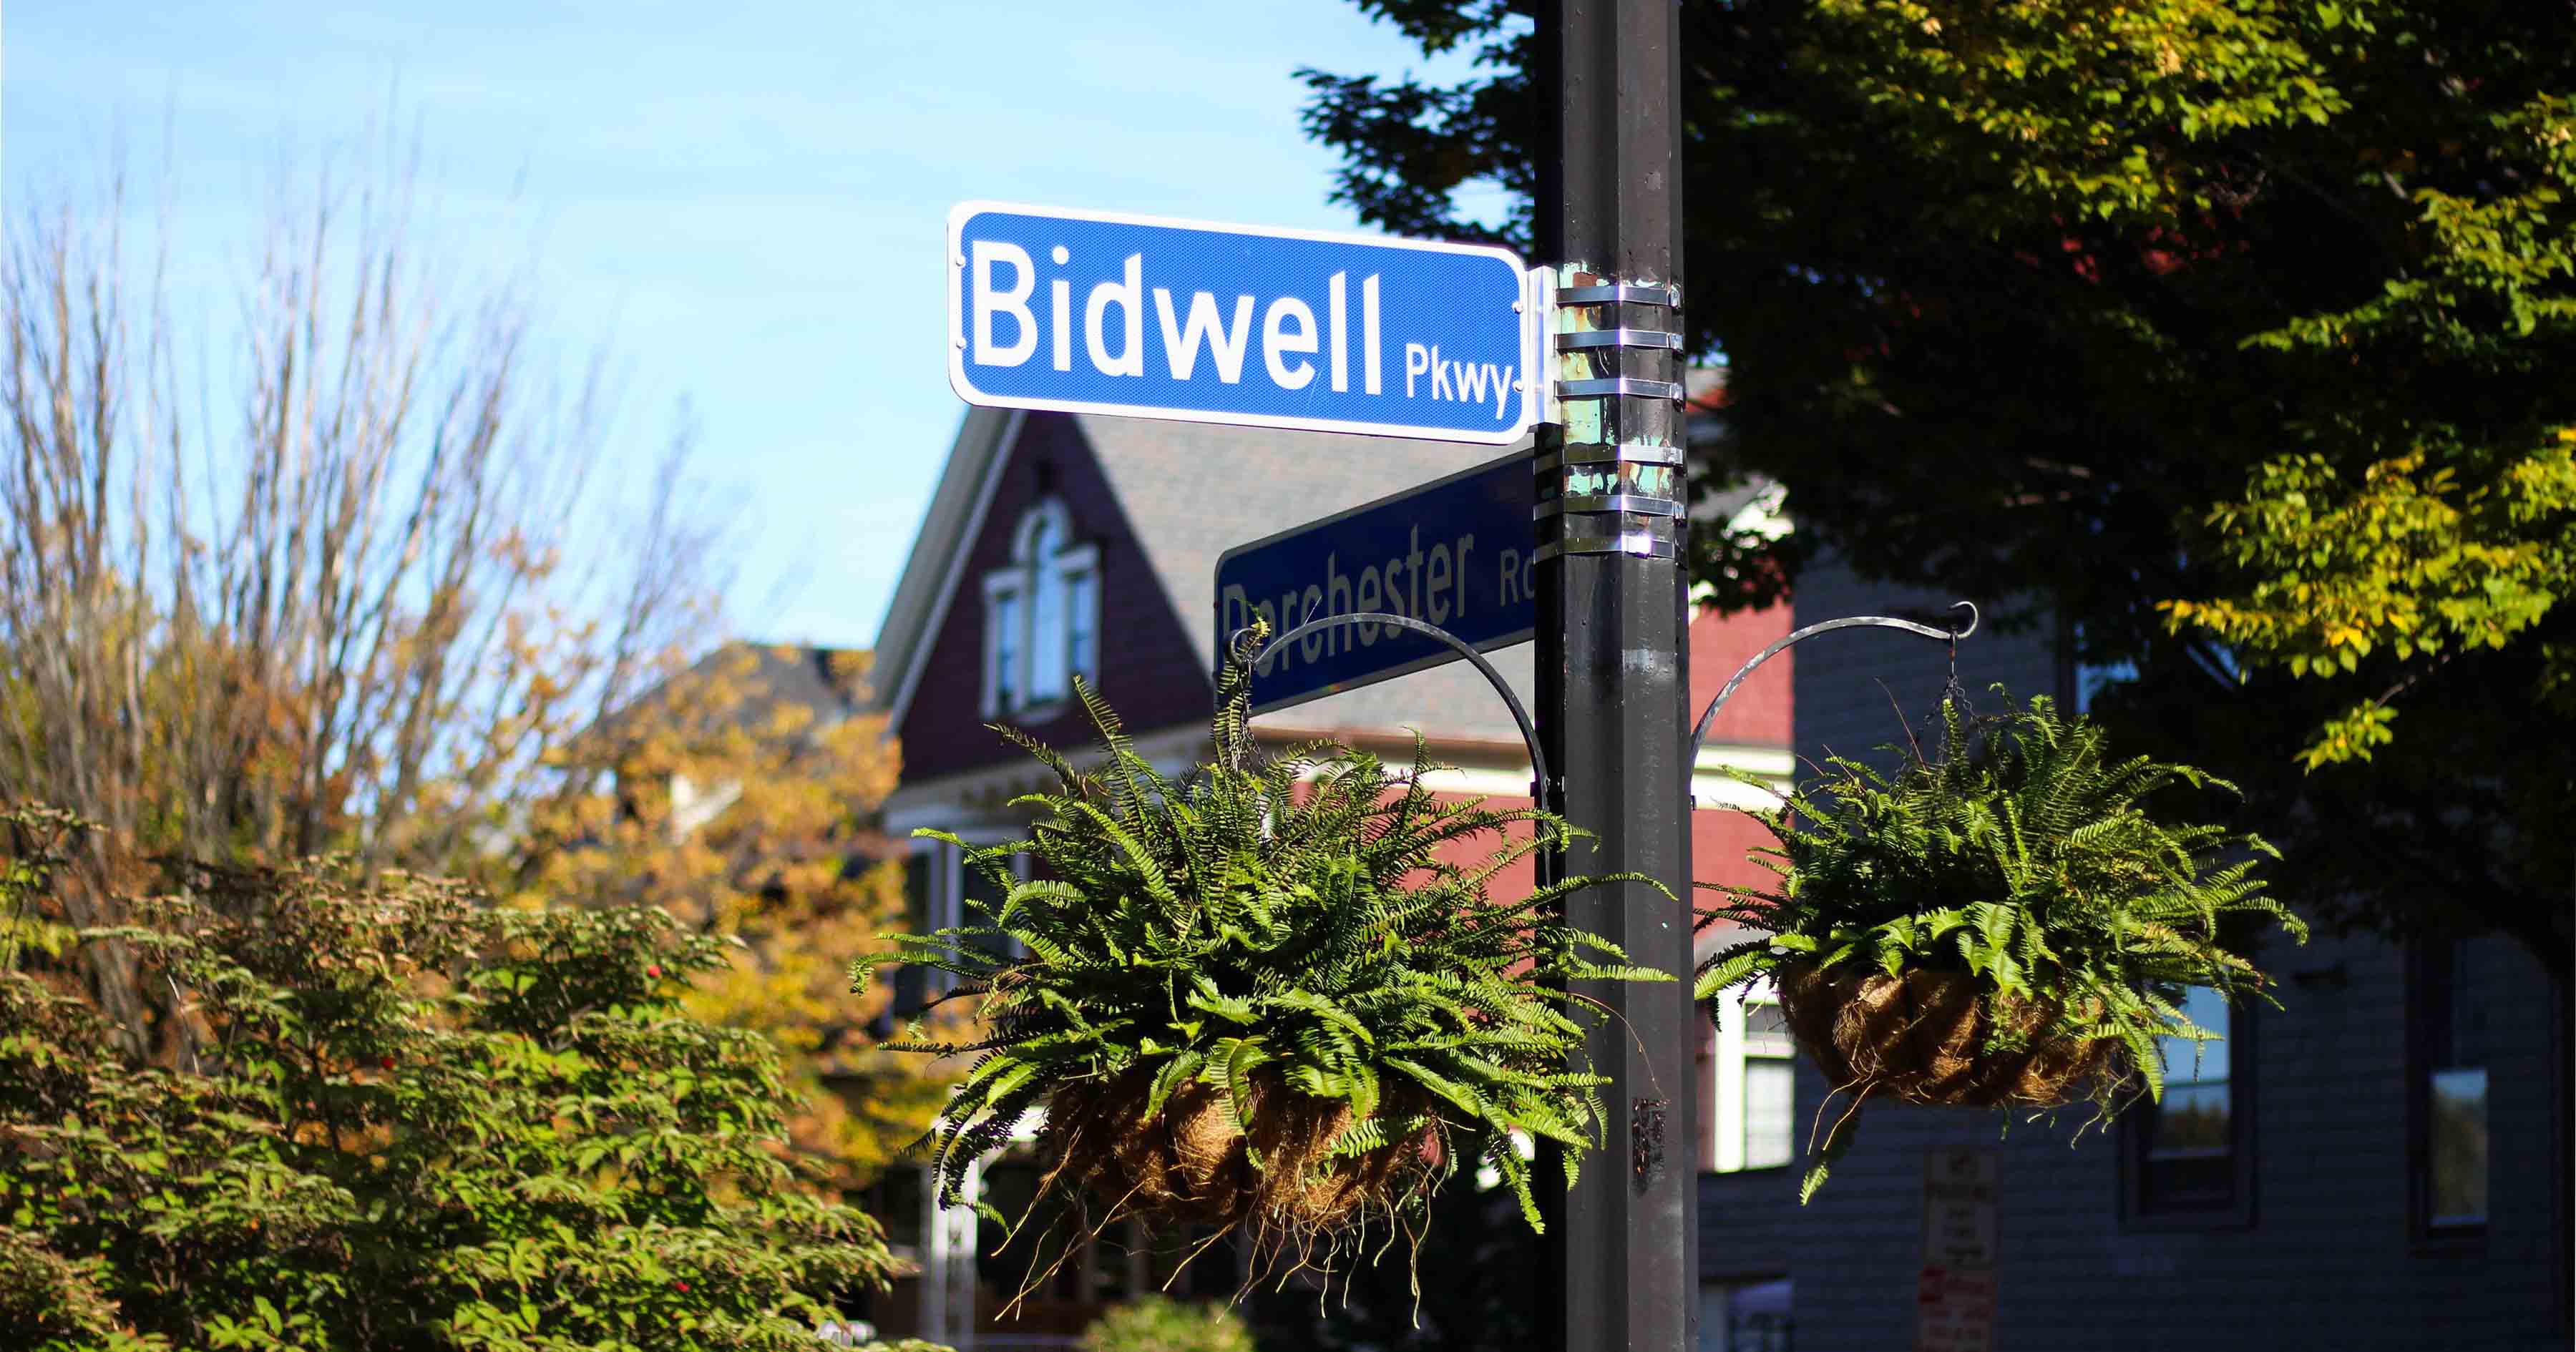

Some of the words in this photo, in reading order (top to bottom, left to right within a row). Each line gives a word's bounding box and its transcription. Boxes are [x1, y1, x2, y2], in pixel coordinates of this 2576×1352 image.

[972, 240, 1382, 396] Bidwell
[1405, 343, 1513, 421] Pkwy
[1222, 523, 1474, 678] Dorchester
